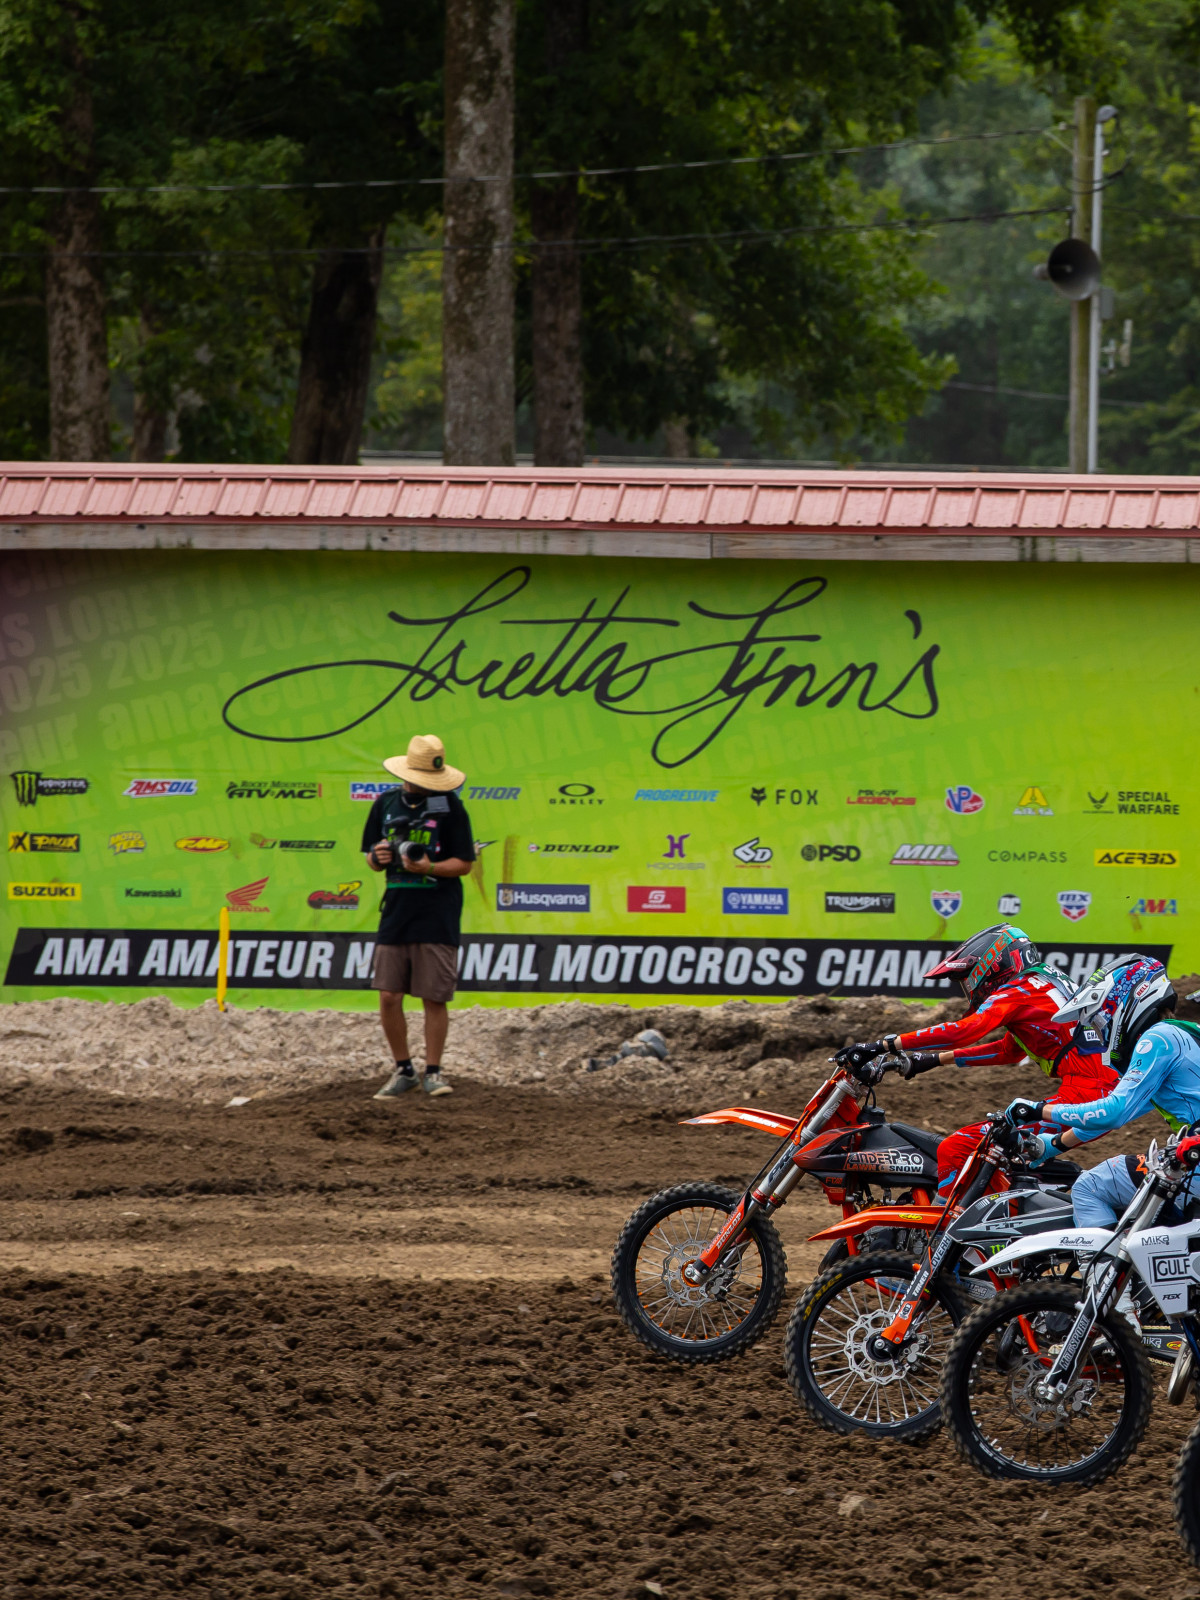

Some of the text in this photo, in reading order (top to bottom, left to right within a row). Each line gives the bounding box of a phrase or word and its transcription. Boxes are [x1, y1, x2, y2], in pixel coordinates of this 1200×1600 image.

[0, 650, 93, 715] 025
[38, 779, 87, 788] MONSTER
[128, 781, 196, 795] AMSOIL
[351, 783, 403, 793] PAR
[468, 787, 522, 800] THOR
[634, 789, 720, 802] PROGRESSIVE
[776, 789, 819, 805] FOX
[1117, 791, 1172, 802] SPECIAL
[1117, 804, 1180, 815] WARFARE
[542, 844, 620, 852] DUNLOP
[818, 845, 861, 861] PSD
[988, 850, 1067, 863] COMPASS
[1097, 852, 1177, 865] ACERBIS
[13, 886, 75, 897] SUZUKI
[125, 888, 182, 898] Kawasaki
[514, 891, 587, 907] Husqvarna
[741, 893, 784, 905] YAMAHA
[826, 895, 881, 906] TRIUMPH
[1129, 899, 1178, 915] AMA
[34, 937, 130, 977] AMA
[138, 939, 336, 979] AMATEUR
[551, 942, 806, 987] MOTOCROSS
[1136, 983, 1149, 997] BELL
[716, 1212, 742, 1250] DUNLOP
[1157, 1258, 1191, 1276] GULF
